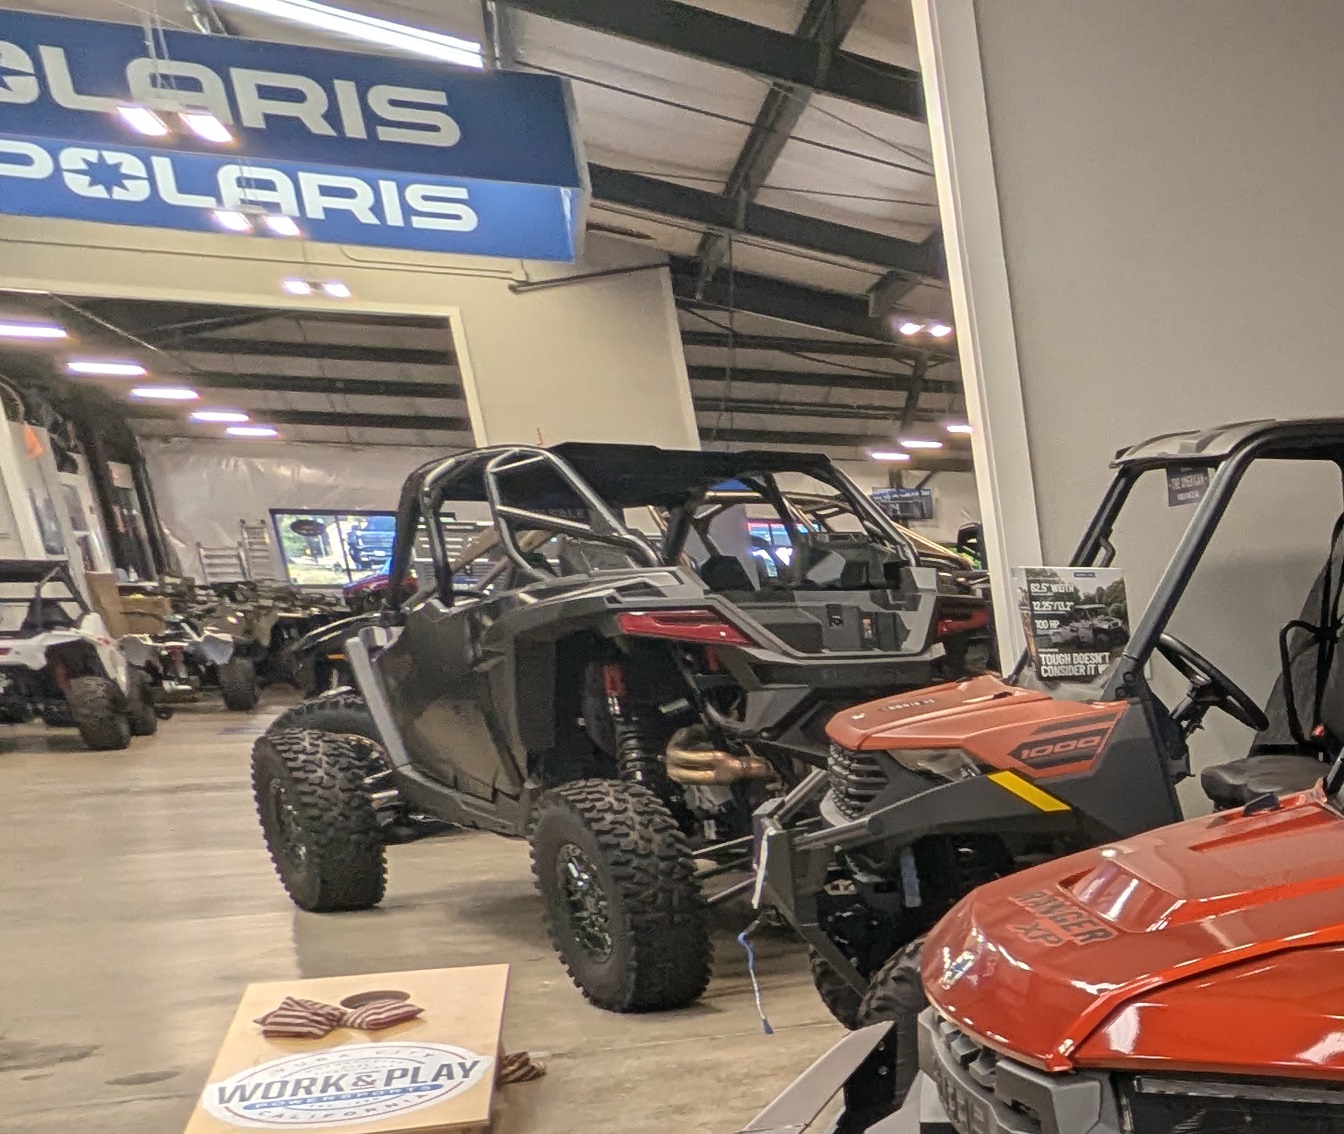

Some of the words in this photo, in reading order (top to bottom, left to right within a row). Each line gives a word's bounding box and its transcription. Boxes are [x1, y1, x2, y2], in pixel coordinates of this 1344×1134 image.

[1039, 653, 1071, 665] TOUGH
[1041, 664, 1086, 677] CONSIDER
[1021, 736, 1100, 760] 1000
[218, 1073, 347, 1105] WORK
[384, 1060, 481, 1087] PLAY
